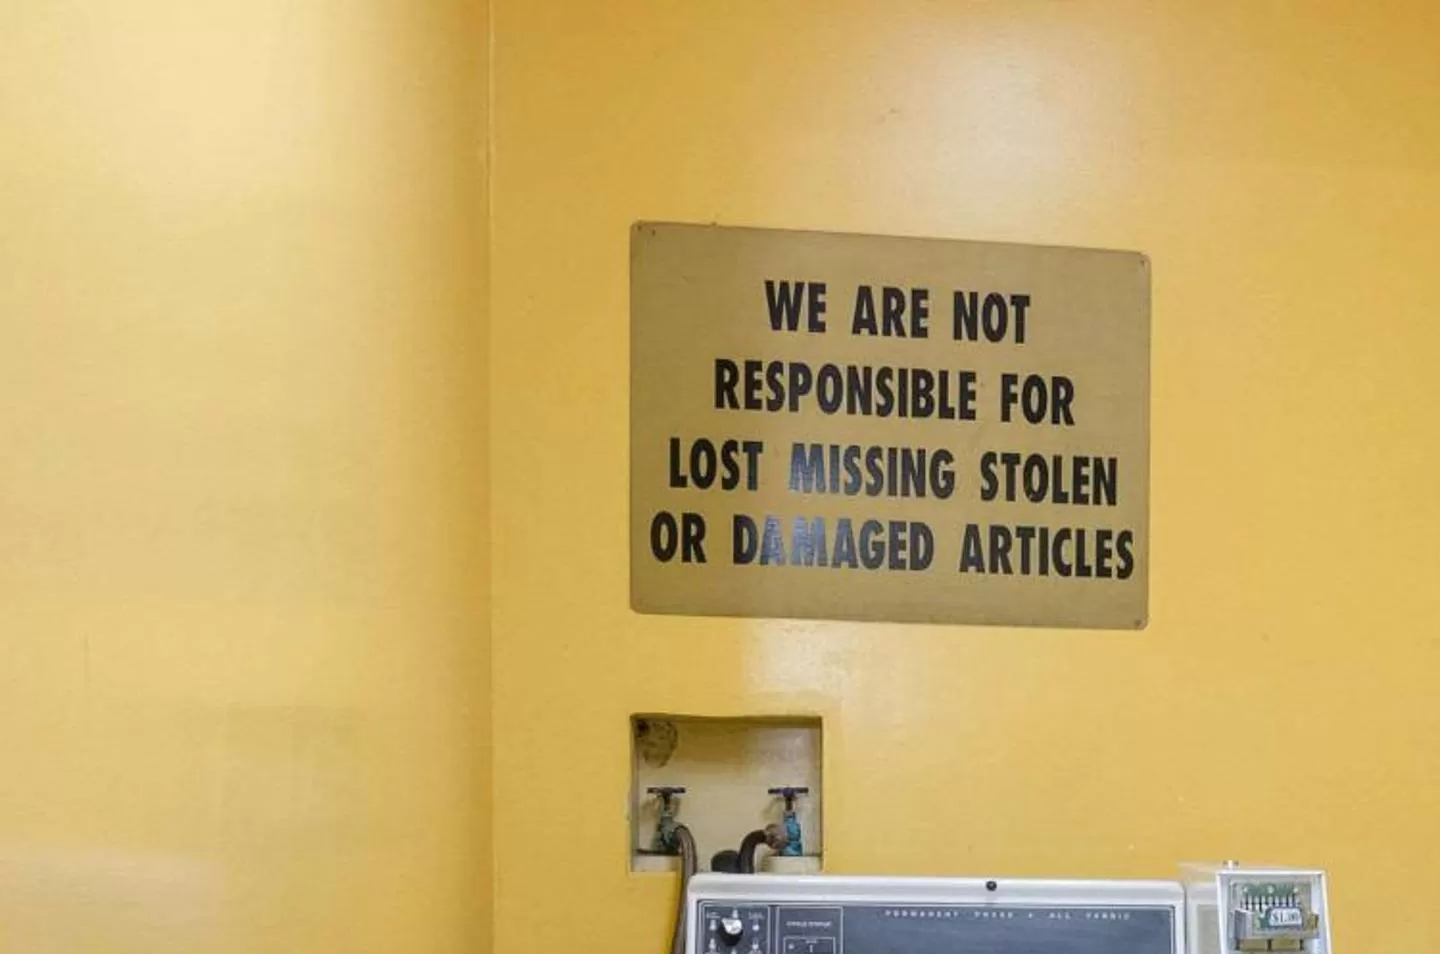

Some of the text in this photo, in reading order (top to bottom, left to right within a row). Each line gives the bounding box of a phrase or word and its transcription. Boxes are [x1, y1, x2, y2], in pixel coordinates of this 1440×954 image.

[765, 280, 1031, 344] WE ARE NOT
[714, 358, 1075, 426] RESPONSIBLE FOR
[669, 437, 1118, 507] LOST MISSING STOLEN
[650, 511, 1135, 580] OR DAMAGED ARTICLES
